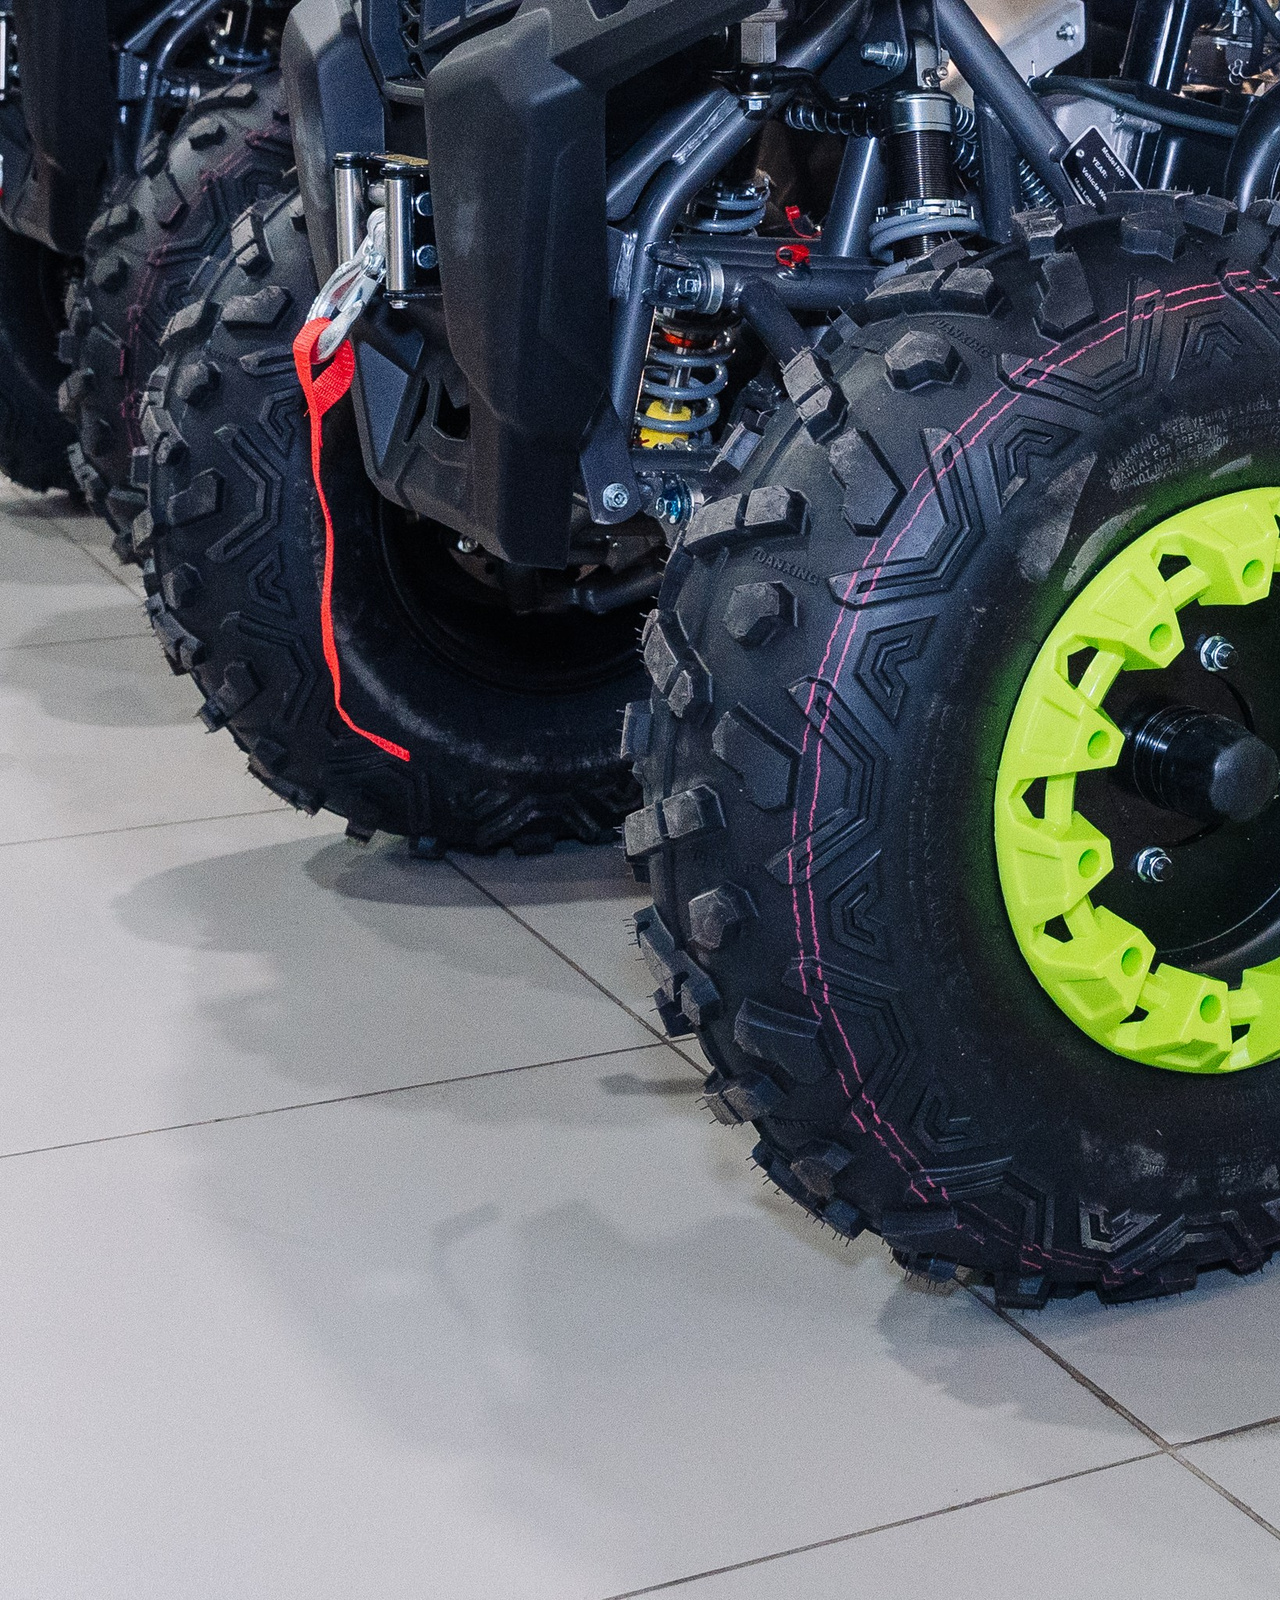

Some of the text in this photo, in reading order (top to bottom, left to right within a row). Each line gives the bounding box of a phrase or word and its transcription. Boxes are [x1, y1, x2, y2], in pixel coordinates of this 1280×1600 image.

[1092, 156, 1109, 179] YEAR:
[1101, 147, 1126, 179] Model NO:
[1081, 166, 1100, 191] Vehicle
